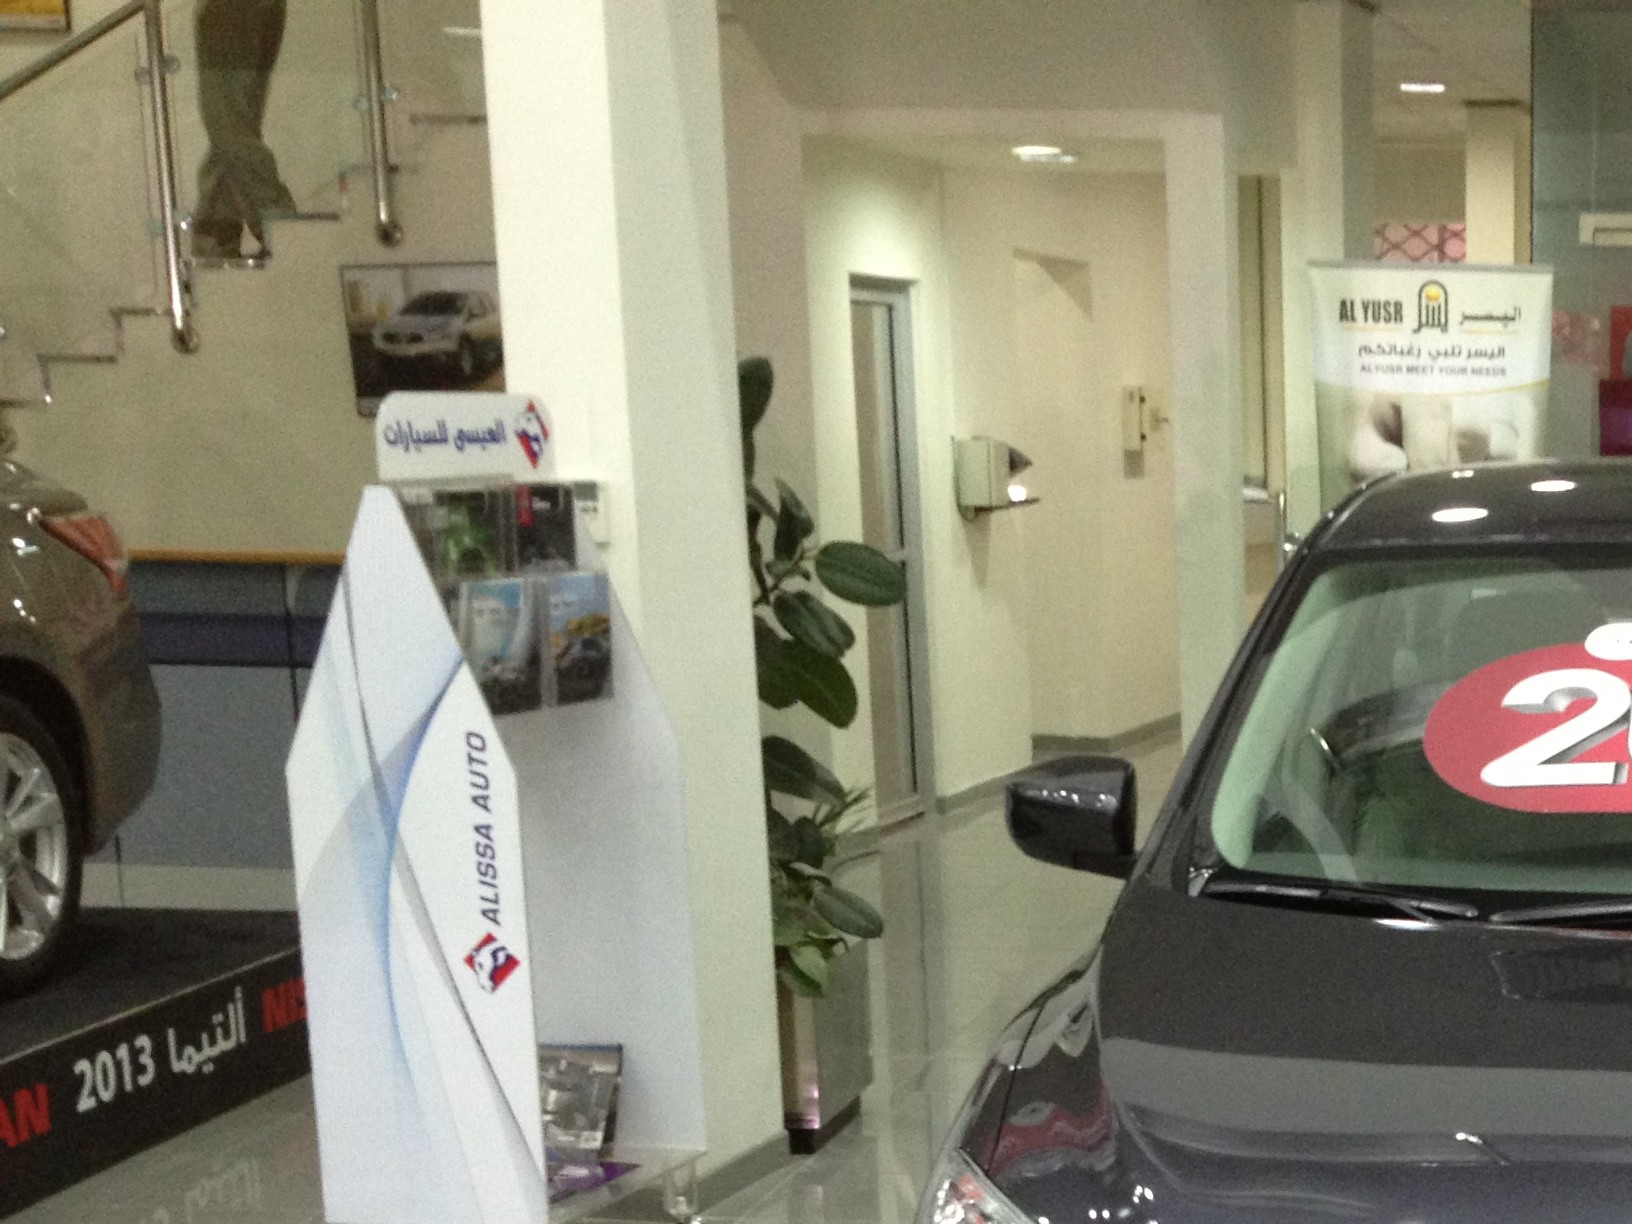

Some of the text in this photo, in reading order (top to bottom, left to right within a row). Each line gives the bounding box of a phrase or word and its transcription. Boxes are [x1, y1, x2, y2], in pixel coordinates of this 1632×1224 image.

[1338, 300, 1357, 323] AL
[1360, 300, 1403, 324] YUSR
[383, 418, 449, 453] للسيارات
[465, 731, 502, 926] ALISSA AUTO
[73, 1033, 156, 1113] 2013
